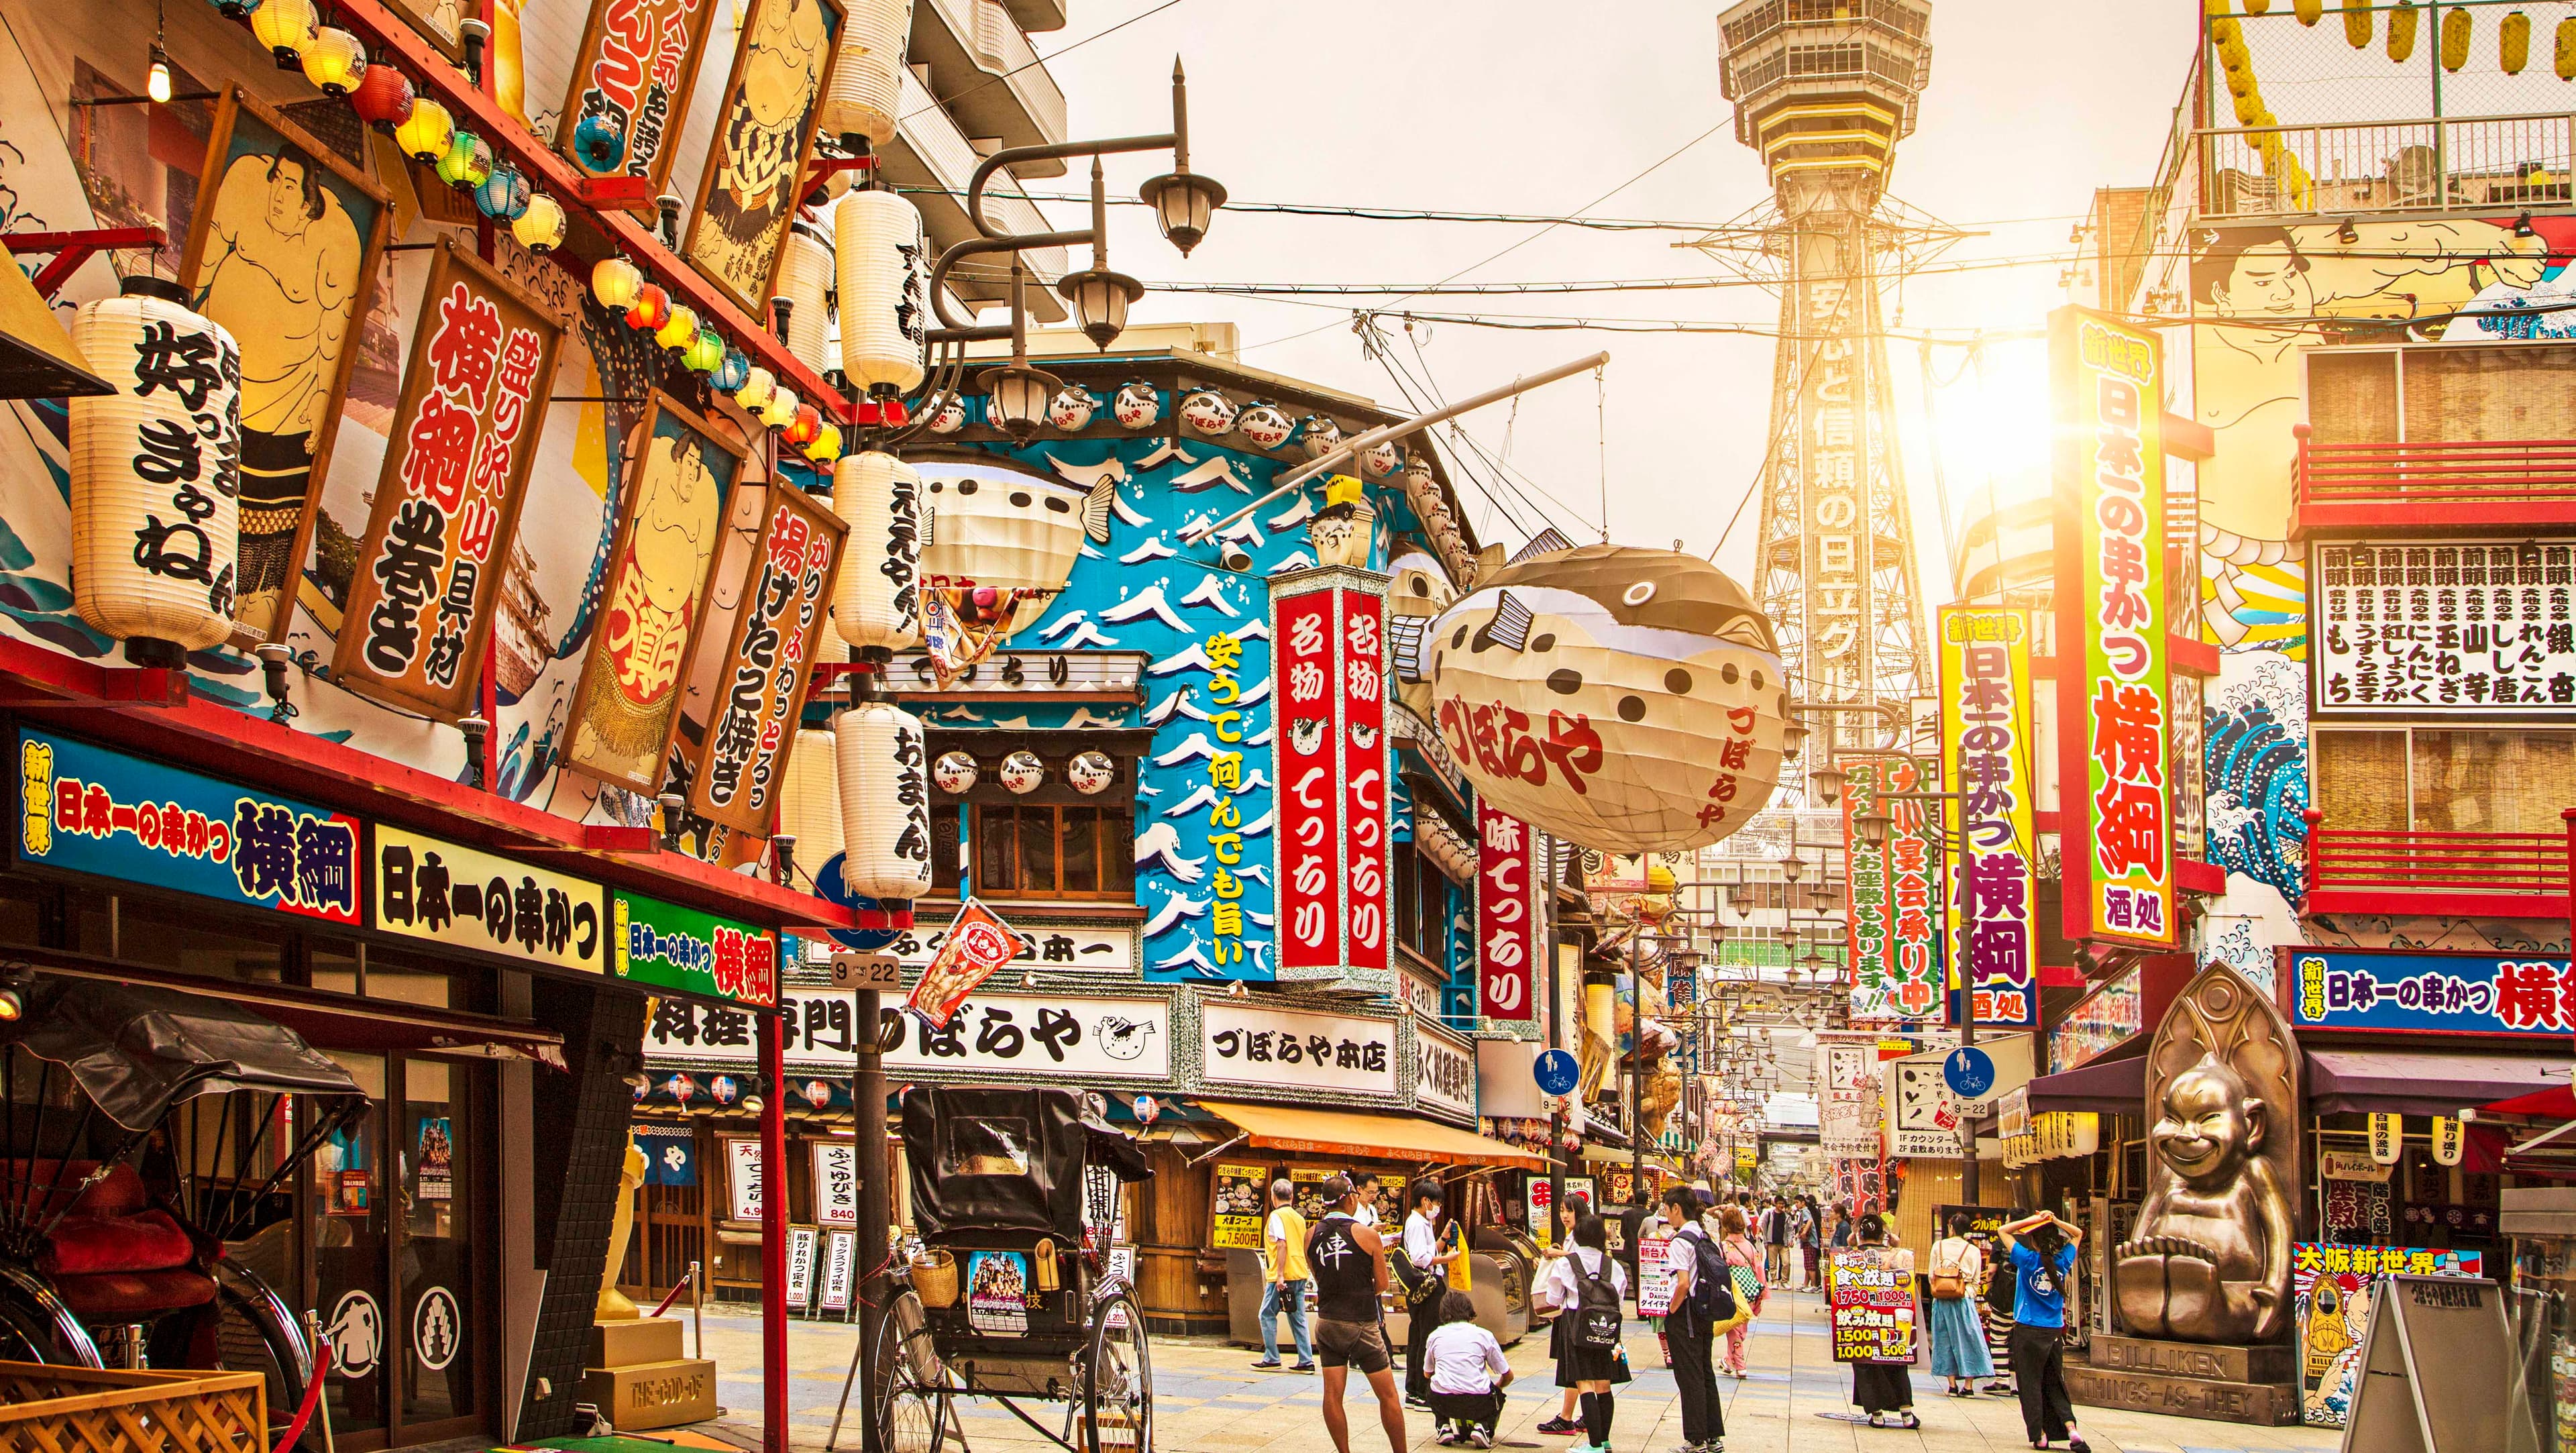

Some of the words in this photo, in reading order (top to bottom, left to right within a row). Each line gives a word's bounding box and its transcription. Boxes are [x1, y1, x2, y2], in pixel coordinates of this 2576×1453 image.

[2082, 324, 2154, 382] 新世界
[365, 283, 501, 674] 横綱巻き
[425, 329, 539, 686] 盛り沢山具材
[2097, 380, 2149, 675] 日本一の串かつ
[2324, 548, 2349, 586] 前頭
[2379, 548, 2404, 586] 前頭
[2406, 548, 2432, 586] 前頭
[2434, 548, 2459, 586] 前頭
[2461, 548, 2487, 586] 前頭
[2489, 548, 2515, 586] 前頭
[2546, 548, 2572, 586] 前頭
[2328, 589, 2348, 621] 変わり種
[2355, 589, 2375, 621] 変わり種
[2382, 589, 2402, 621] 変わり種
[2410, 589, 2430, 621] 天地の幸
[2437, 589, 2457, 621] 天地の幸
[2465, 589, 2485, 621] 天地の幸
[2493, 589, 2513, 621] 天地の幸
[2520, 589, 2541, 621] 天地の幸
[2548, 589, 2569, 621] 天地の幸
[1947, 613, 2023, 645] 新世界
[710, 506, 807, 806] 揚げたこ焼き
[1289, 612, 1323, 703] 名物
[1347, 612, 1379, 702] 名物
[2326, 624, 2351, 703] もち
[2353, 624, 2381, 703] うずら玉子
[2380, 624, 2408, 703] 紅しょうが
[2406, 624, 2434, 703] にんにく
[2435, 624, 2463, 703] 玉ねぎ
[2463, 624, 2489, 703] 山芋
[2491, 624, 2518, 703] しし唐
[2518, 624, 2546, 703] れんこん
[2546, 624, 2575, 703] 銀杏
[1439, 695, 1603, 795] づぼらや
[1696, 706, 1759, 829] づぼらや
[1962, 647, 2015, 848] 日本一の串かつ
[23, 741, 52, 853] 新世界
[2093, 680, 2165, 885] 横綱
[56, 778, 230, 861] 日本一の串かつ
[234, 800, 355, 914] 横綱
[1290, 766, 1326, 948] てっちり
[1349, 767, 1382, 949] てっちり
[381, 844, 598, 961] 日本一の串かつ
[1485, 800, 1524, 1011] 味てっちり
[1892, 763, 1933, 1014] 大小宴会承り中
[2105, 888, 2162, 933] 酒処
[615, 899, 629, 976] 新世界
[1952, 853, 2029, 987] 横綱
[630, 922, 712, 973] 日本一の串かつ
[713, 926, 775, 1003] 横綱
[1410, 979, 1432, 1012] てっちり
[2302, 960, 2326, 1019] 新世界
[2328, 973, 2490, 1012] 日本一の串かつ
[1212, 1028, 1387, 1073] づぼらや本店
[1954, 1104, 1985, 1114] 9-22
[1823, 1142, 1878, 1152] 宴会予約受付中
[2335, 1161, 2376, 1173] 角ハイボール
[828, 1148, 855, 1205] ふぐゆびき
[830, 1209, 855, 1220] 840
[792, 1234, 810, 1288] 豚ひれかつ定食
[1227, 1232, 1259, 1246] 7,500円
[1834, 1253, 1867, 1270] 串かつ
[2297, 1246, 2436, 1275] 大阪新世界
[832, 1236, 846, 1292] ミックスフライ定食
[1834, 1268, 1896, 1287] 食べ放題
[1835, 1309, 1894, 1328] 飲み放題
[1836, 1329, 1879, 1343] 1,500円
[1836, 1345, 1879, 1359] 1,000円
[1882, 1345, 1913, 1356] 500円
[2106, 1343, 2227, 1378] BILLIKEN
[2082, 1375, 2253, 1415] THINGS-AS-THEY
[2304, 1407, 2346, 1424] ようこそ
